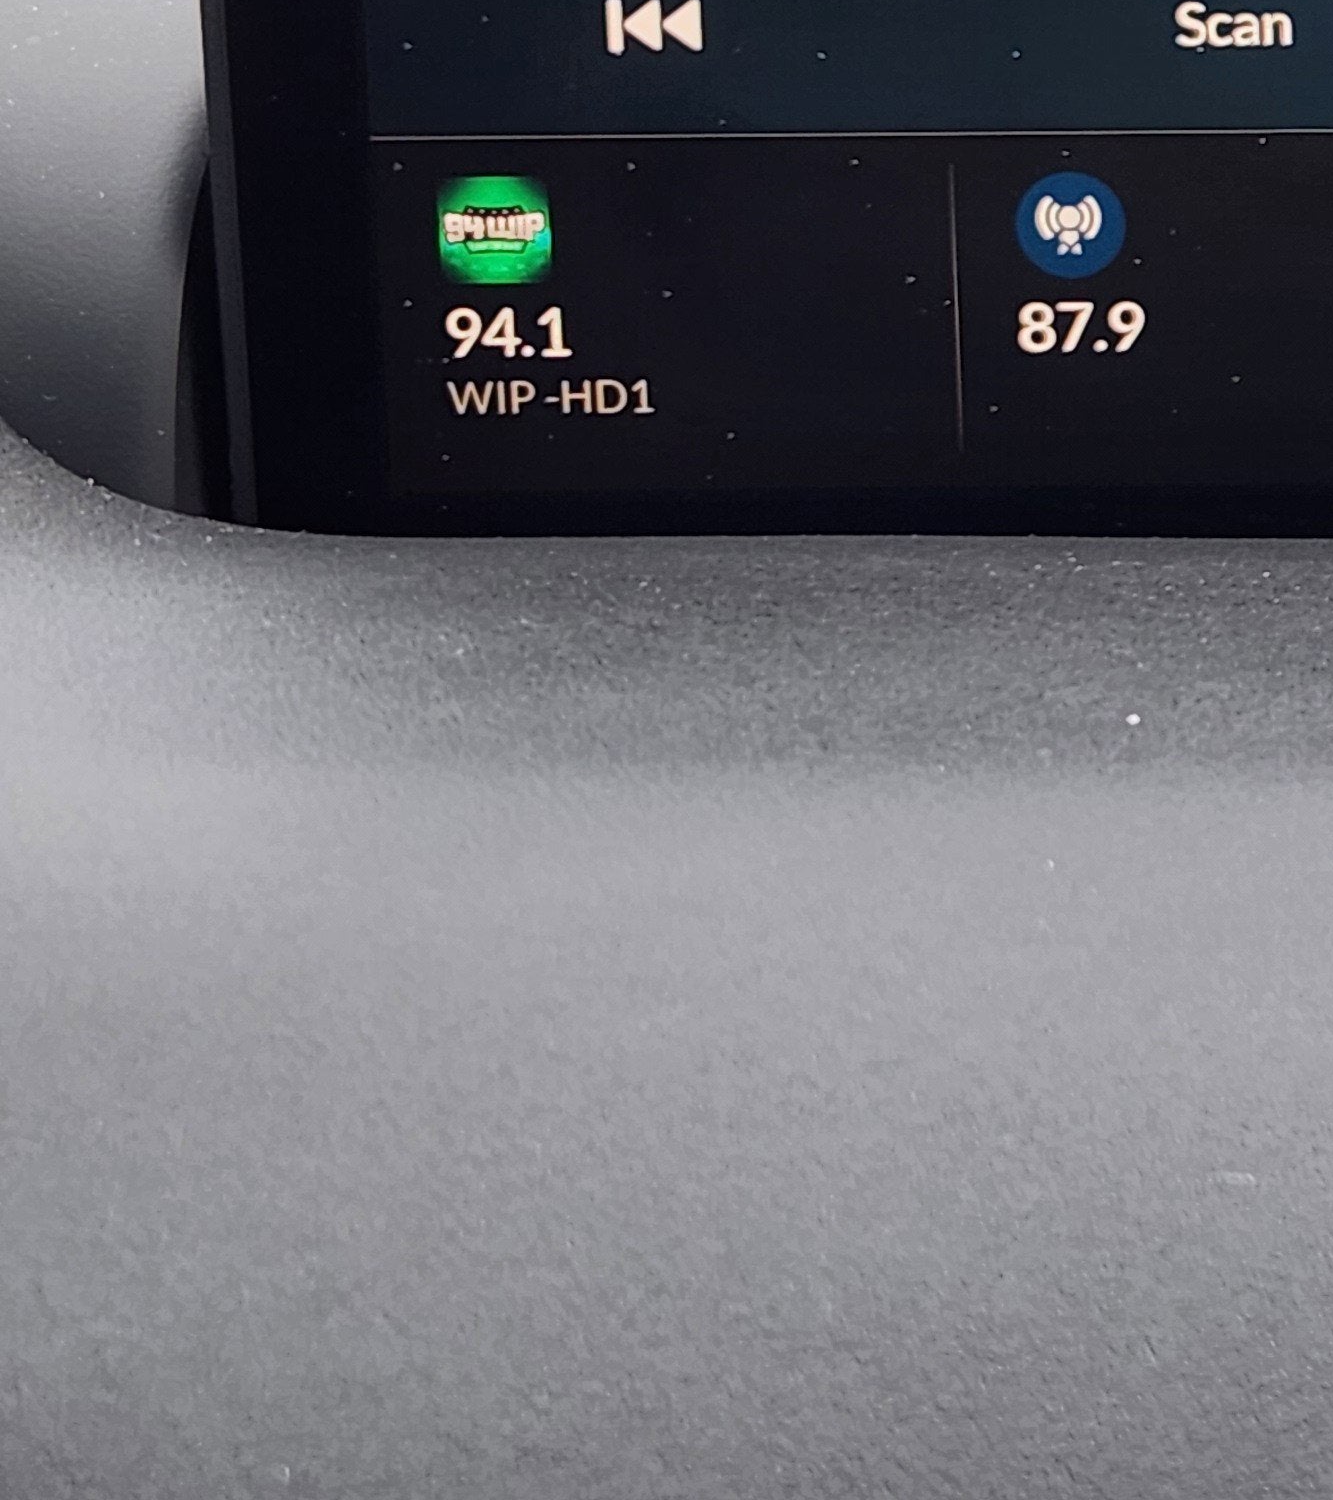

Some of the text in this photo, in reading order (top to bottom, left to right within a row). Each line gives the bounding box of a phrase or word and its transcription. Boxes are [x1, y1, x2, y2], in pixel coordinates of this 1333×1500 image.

[1173, 1, 1295, 50] Scan
[443, 211, 545, 243] 94 WIP
[444, 306, 574, 360] 94.1
[1016, 301, 1147, 354] 87.9
